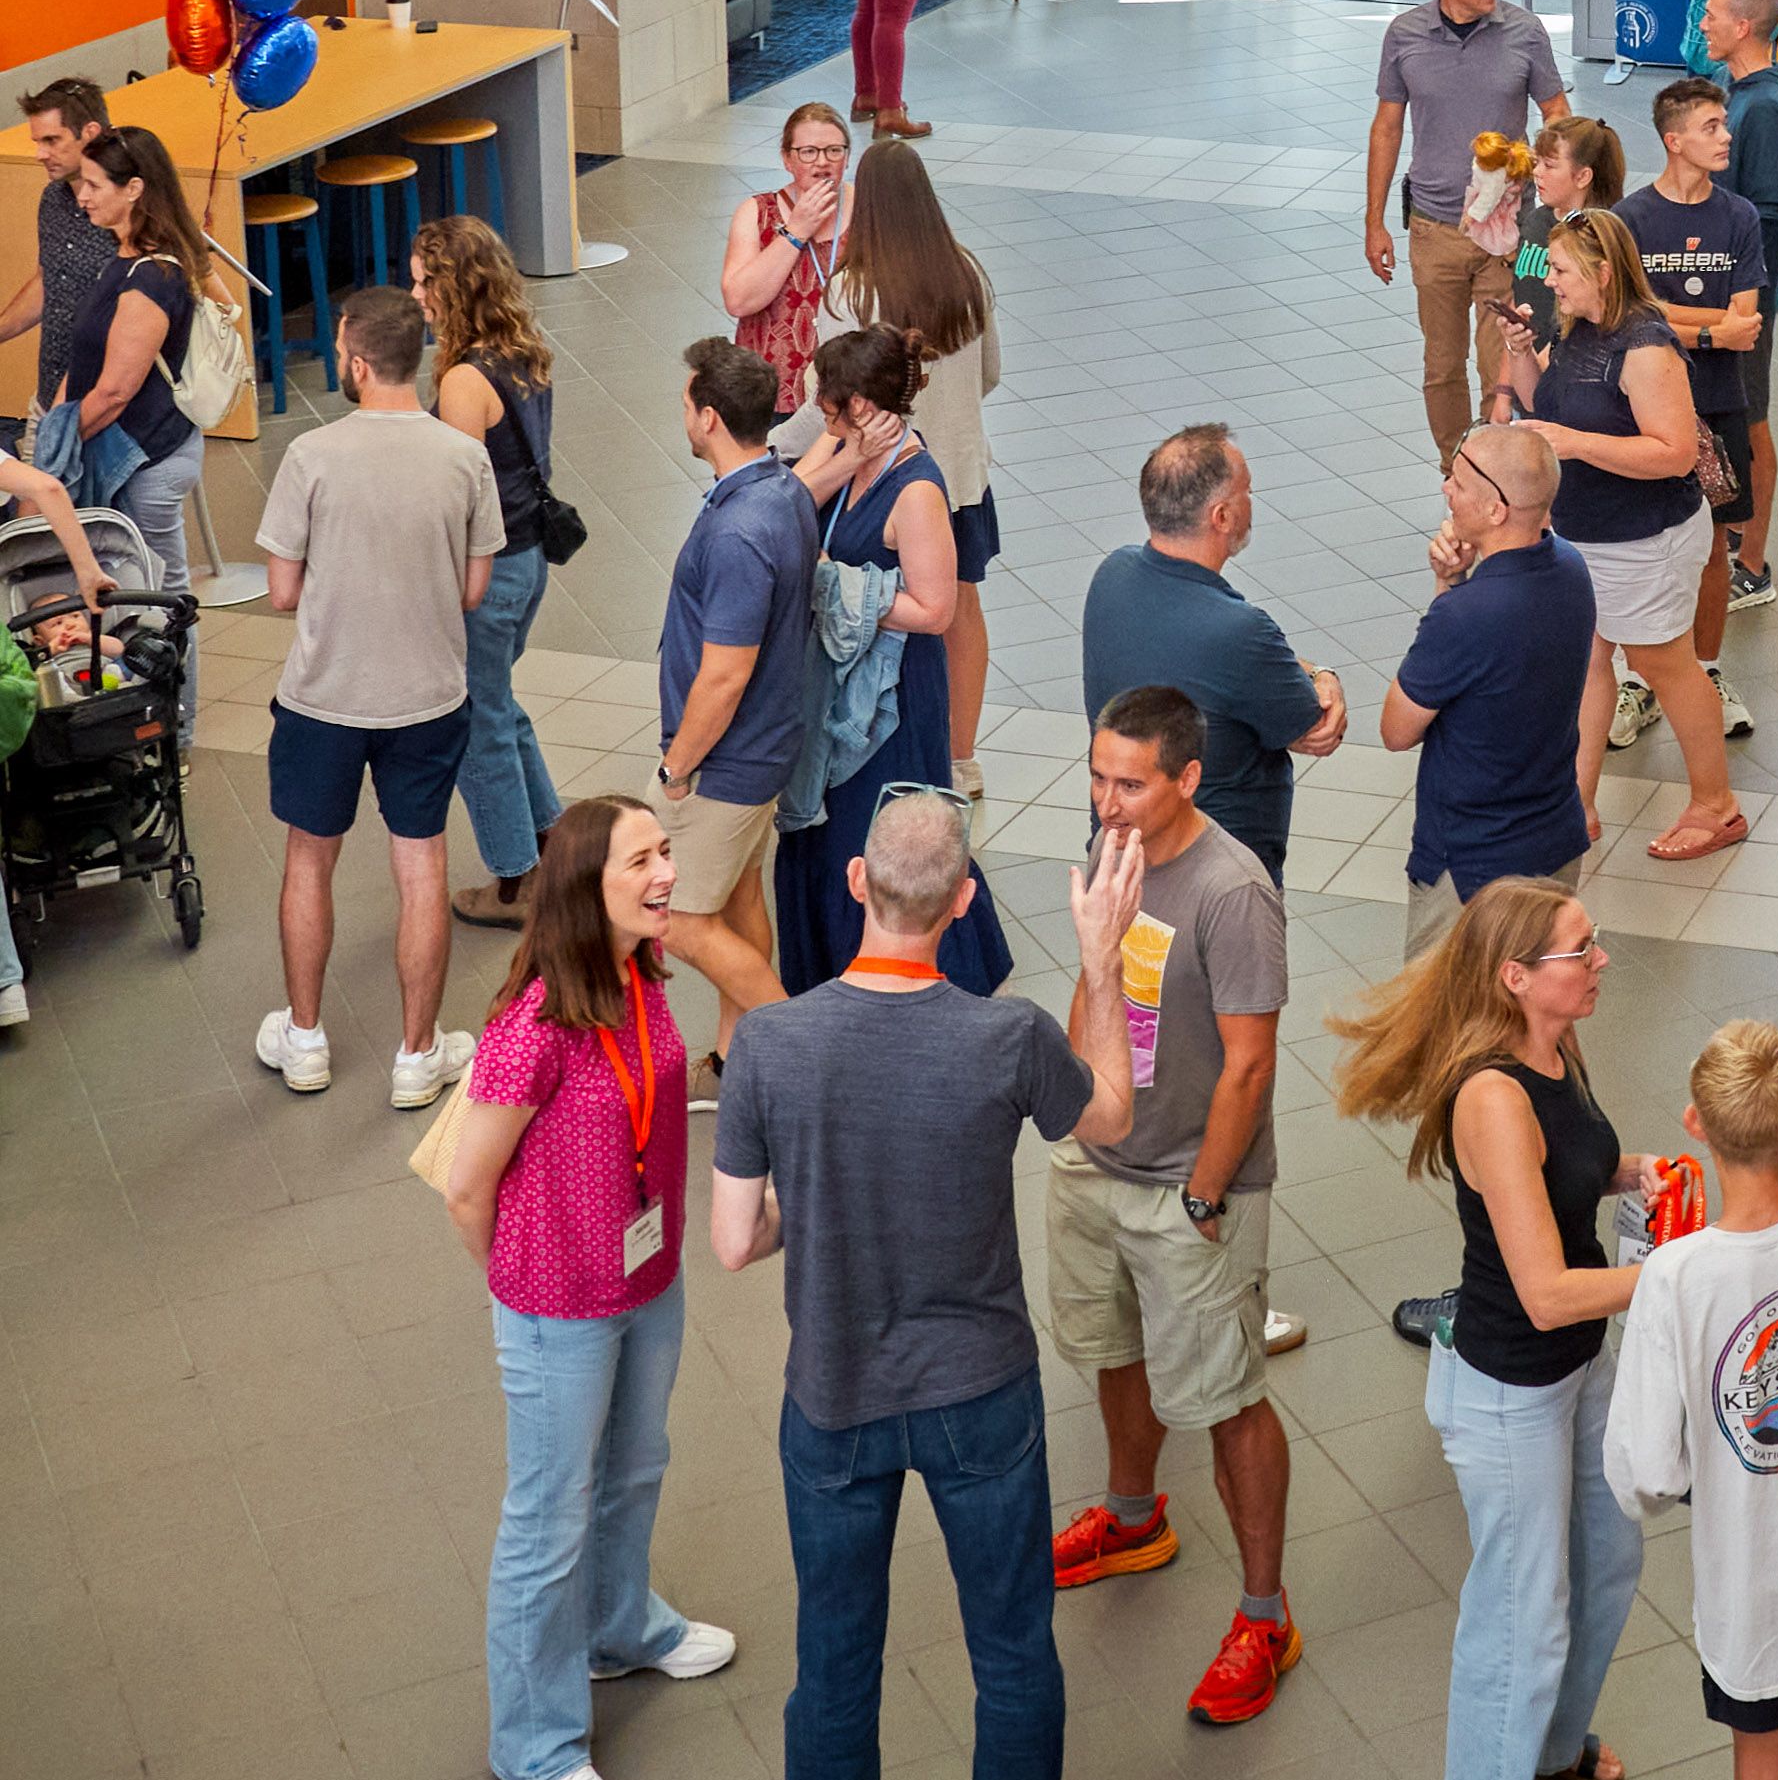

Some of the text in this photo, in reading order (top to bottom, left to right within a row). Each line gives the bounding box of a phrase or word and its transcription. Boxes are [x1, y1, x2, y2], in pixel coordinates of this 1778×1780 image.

[1515, 239, 1550, 280] WIC
[1641, 253, 1738, 267] BASEBAL
[1737, 1320, 1762, 1354] GOT
